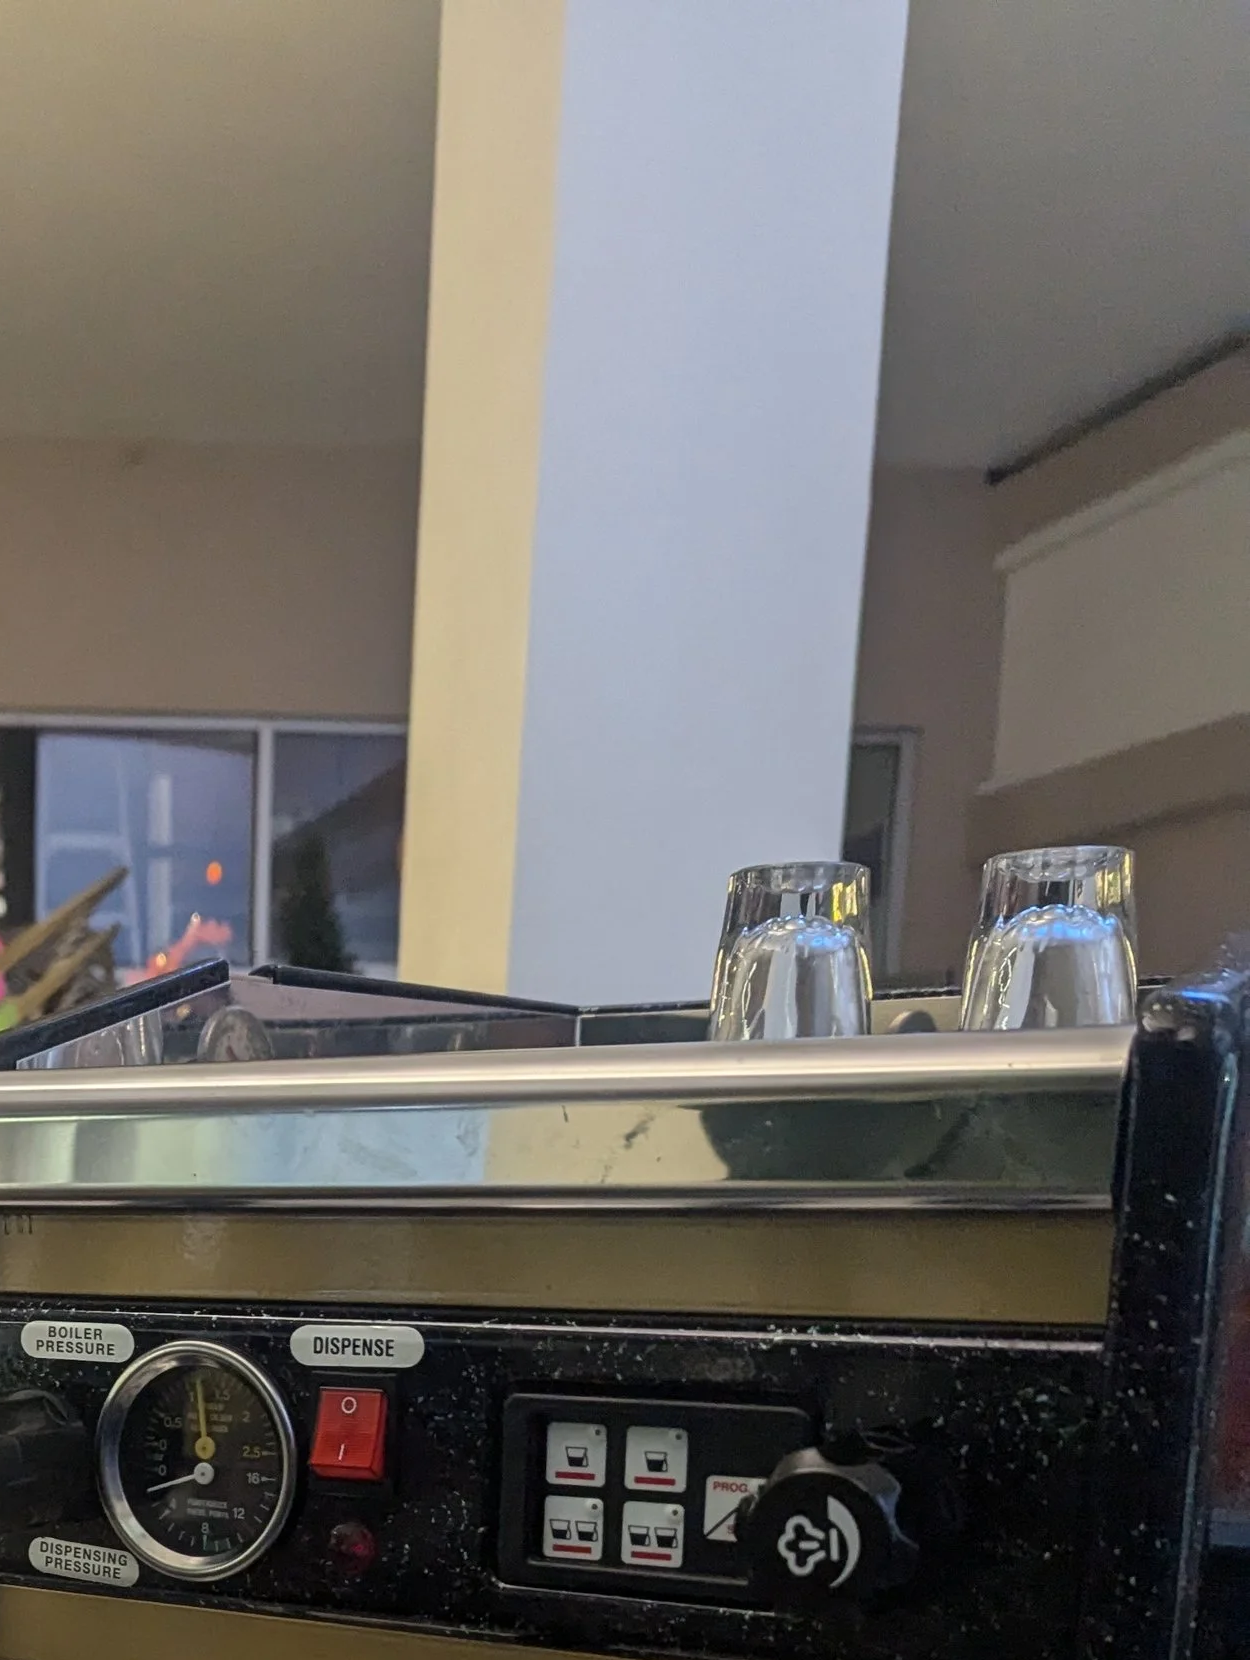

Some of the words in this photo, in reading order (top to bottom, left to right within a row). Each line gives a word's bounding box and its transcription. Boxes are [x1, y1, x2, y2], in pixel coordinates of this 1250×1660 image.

[48, 1325, 103, 1340] BOILER
[36, 1339, 115, 1356] PRESSURE
[313, 1336, 395, 1357] DISPENSE
[163, 1416, 183, 1428] 0.5
[242, 1410, 251, 1423] 2
[242, 1446, 261, 1458] 2.5
[246, 1472, 260, 1485] 16
[233, 1508, 246, 1520] 12
[200, 1522, 209, 1533] 8
[40, 1541, 128, 1567] DISPENSING
[45, 1555, 121, 1580] PRESSURE
